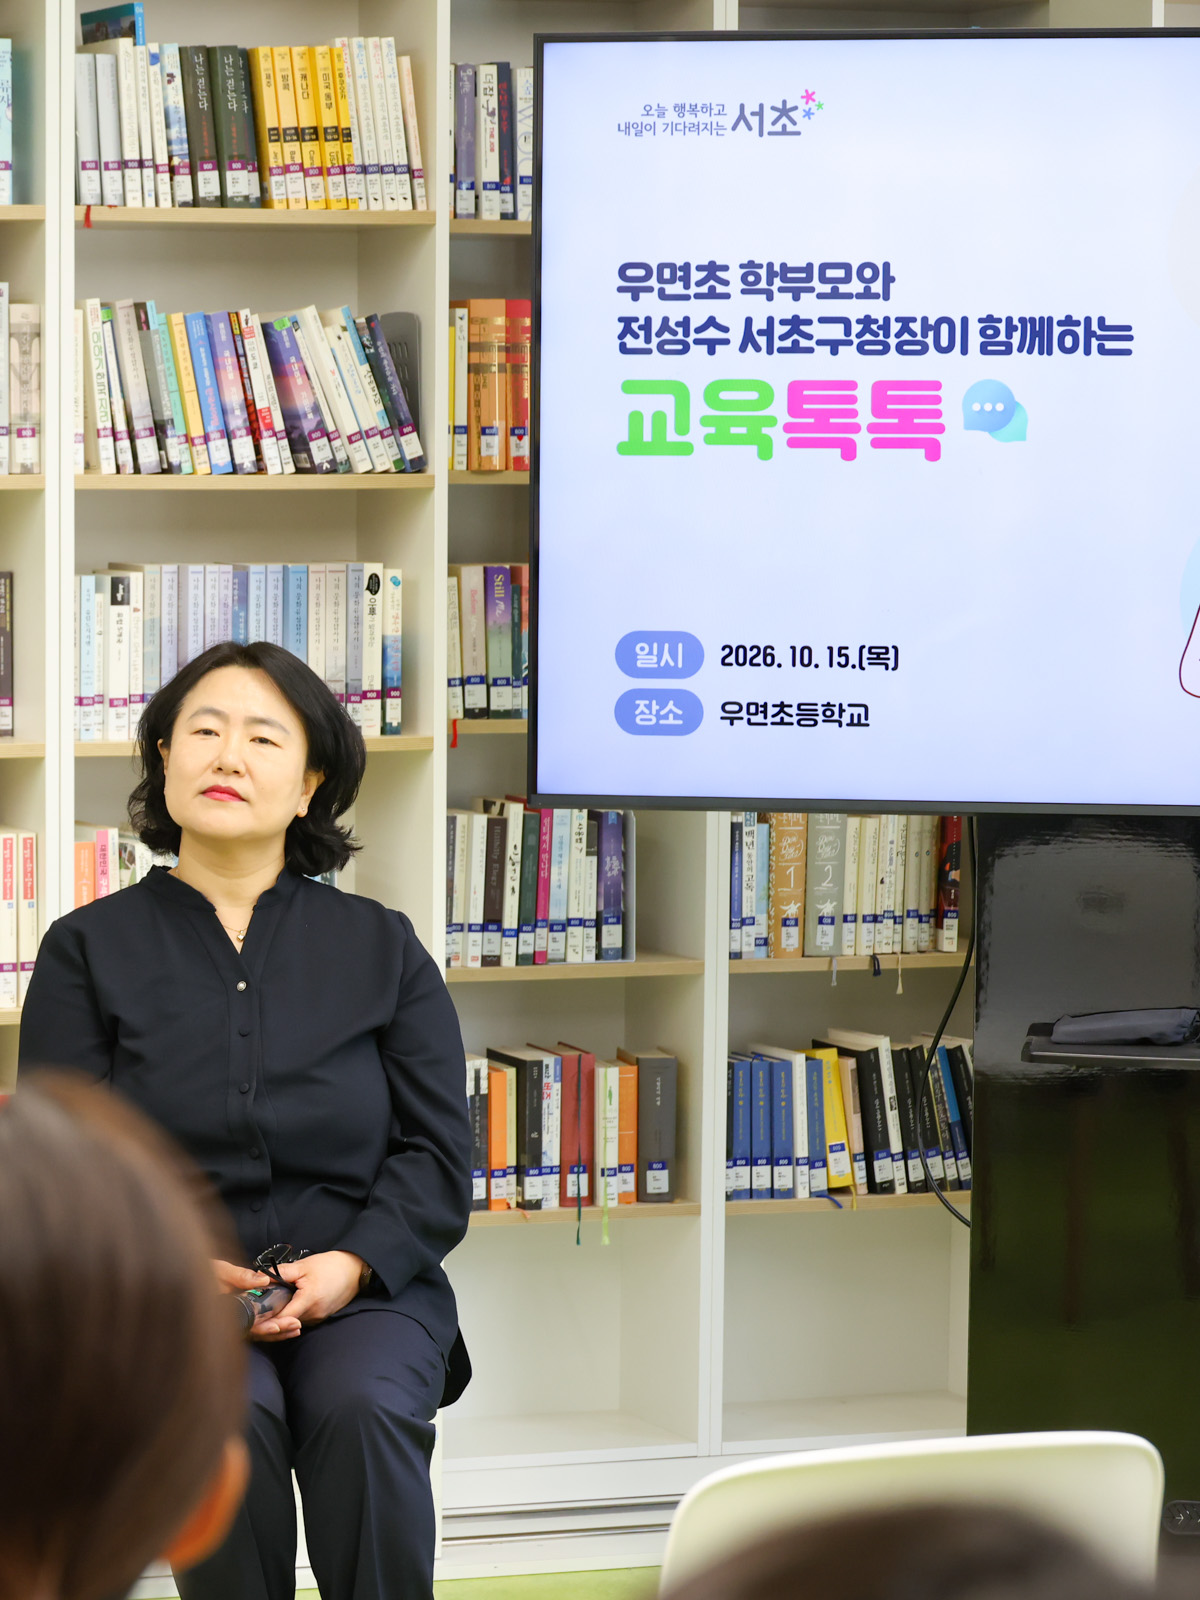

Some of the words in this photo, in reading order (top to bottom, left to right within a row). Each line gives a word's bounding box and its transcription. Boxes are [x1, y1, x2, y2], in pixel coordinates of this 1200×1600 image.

[300, 73, 310, 100] 캐나다
[641, 102, 668, 119] 오늘
[672, 102, 727, 119] 행복하고
[731, 99, 802, 138] 서초
[616, 120, 658, 137] 내일이
[661, 120, 727, 137] 기다려지는
[616, 260, 731, 302] 우면초
[739, 259, 896, 302] 학부모와
[616, 315, 731, 356] 전성수
[739, 315, 970, 357] 서초구청장이
[977, 315, 1135, 357] 함께하는
[92, 331, 104, 370] 이야기
[616, 378, 947, 462] 교육톡톡
[494, 574, 505, 598] Still
[495, 600, 505, 617] Me
[634, 642, 684, 669] 일시
[720, 644, 783, 669] 2026.
[789, 644, 819, 669] 10.
[826, 643, 900, 671] 15.(목)
[634, 699, 684, 726] 장소
[720, 700, 871, 729] 우면초등학교
[745, 829, 755, 849] 백년
[99, 844, 107, 876] 대한민국
[745, 875, 755, 892] 고독
[786, 866, 795, 888] 1
[822, 865, 833, 887] 2
